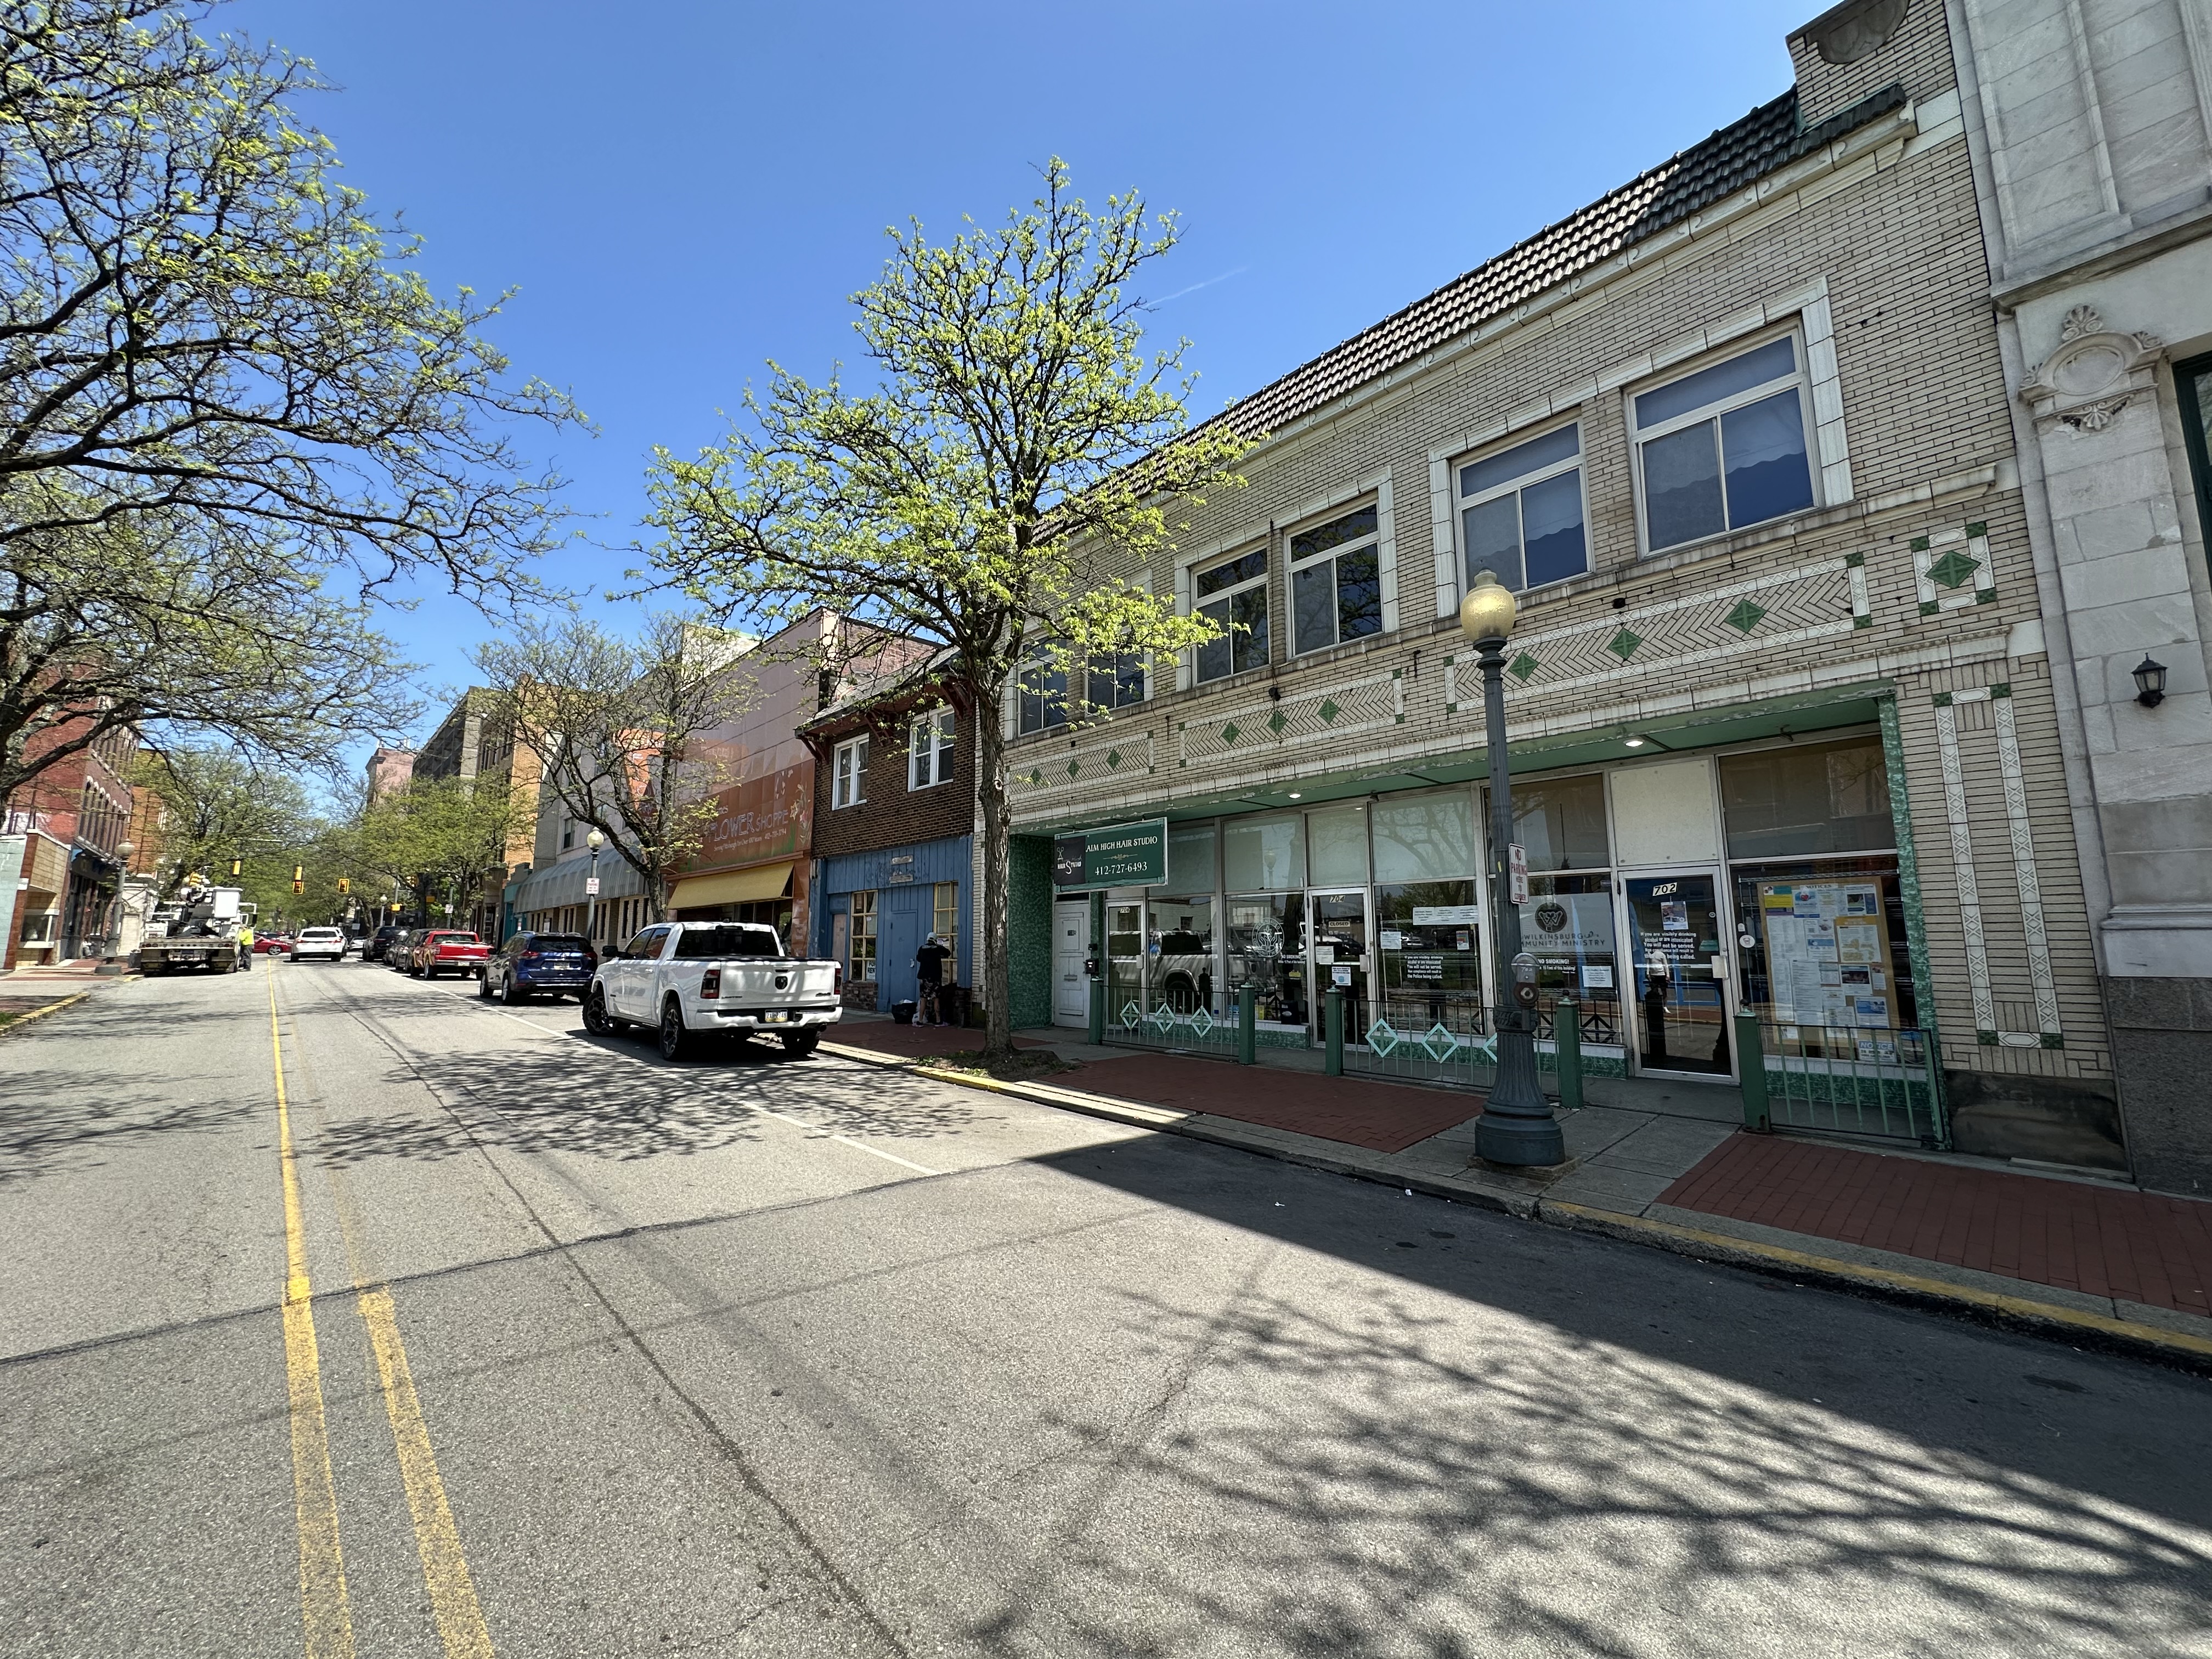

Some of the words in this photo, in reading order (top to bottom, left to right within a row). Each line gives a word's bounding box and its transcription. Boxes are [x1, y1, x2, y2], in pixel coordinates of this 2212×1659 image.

[755, 809, 788, 832] SHOPPE
[1086, 844, 1099, 853] AIM
[1101, 842, 1115, 851] HIGH
[1116, 839, 1132, 848] HAIR
[1133, 836, 1158, 847] STUDIO
[1515, 849, 1521, 861] NO
[1094, 861, 1147, 876] 412-727-6493
[1510, 862, 1527, 875] PARKING
[1654, 884, 1676, 895] 702
